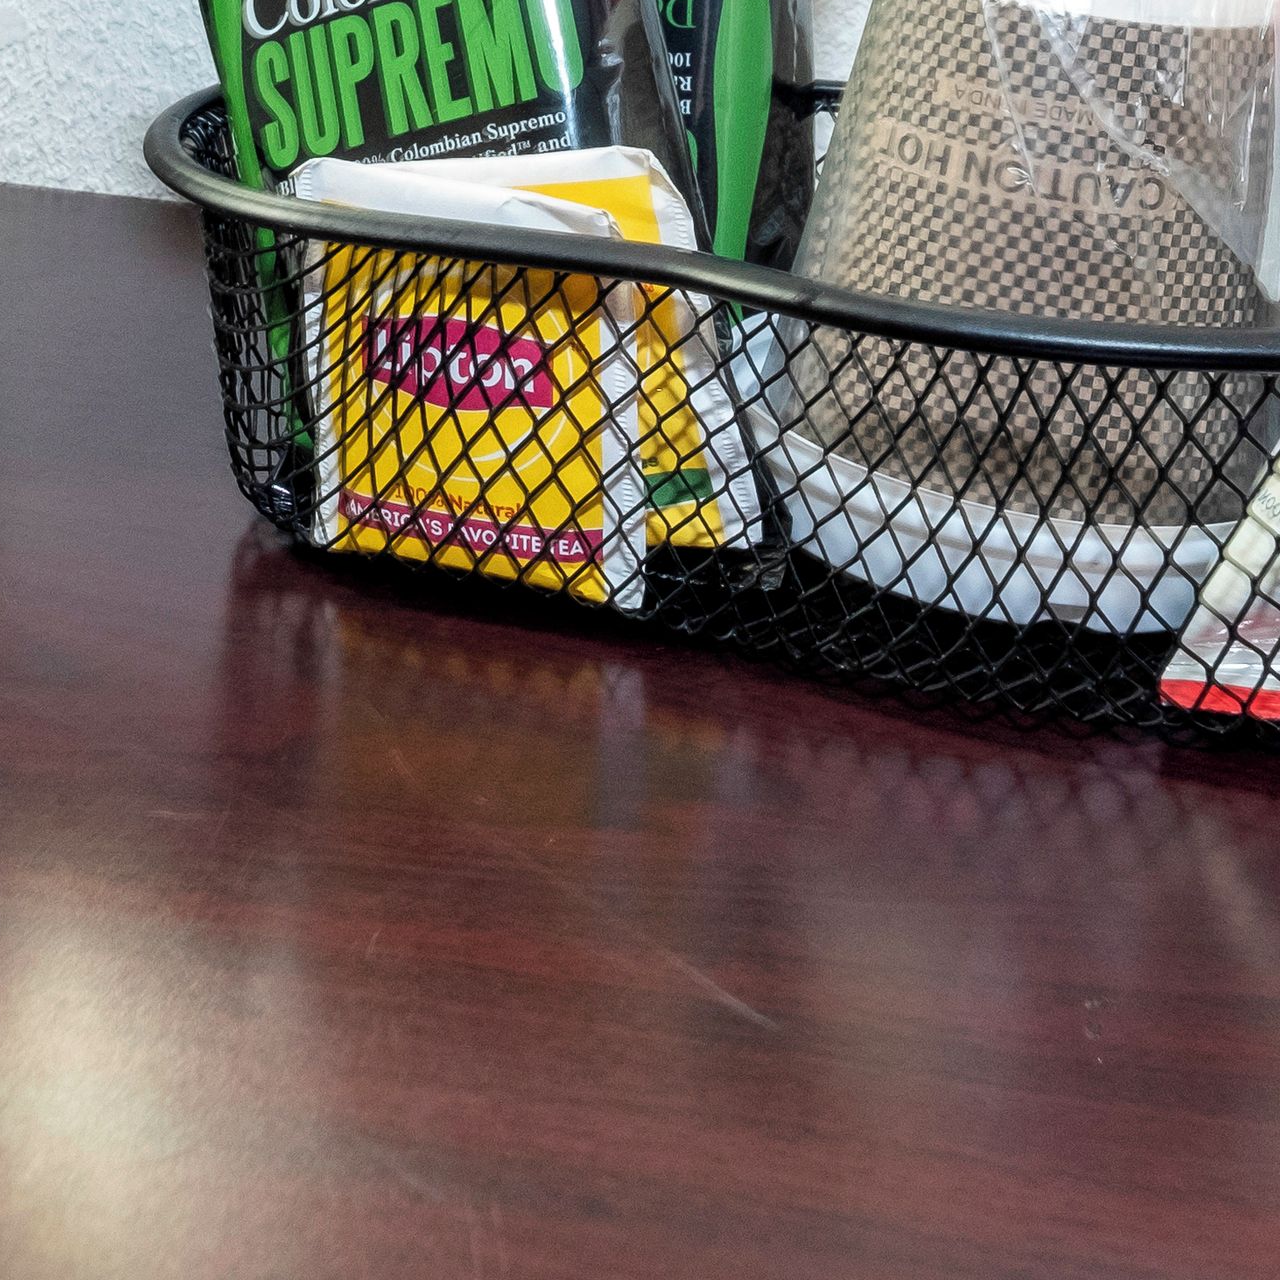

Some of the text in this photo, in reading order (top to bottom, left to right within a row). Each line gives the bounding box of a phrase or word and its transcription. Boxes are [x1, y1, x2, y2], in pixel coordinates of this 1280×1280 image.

[390, 130, 484, 164] Colombian
[486, 110, 567, 145] Supremo
[1030, 99, 1098, 127] MADE
[537, 132, 572, 154] and
[963, 150, 1166, 211] CAUTON
[376, 327, 535, 394] Lipton
[347, 498, 443, 537] AMRIC'S
[447, 523, 542, 554] FAVOITE
